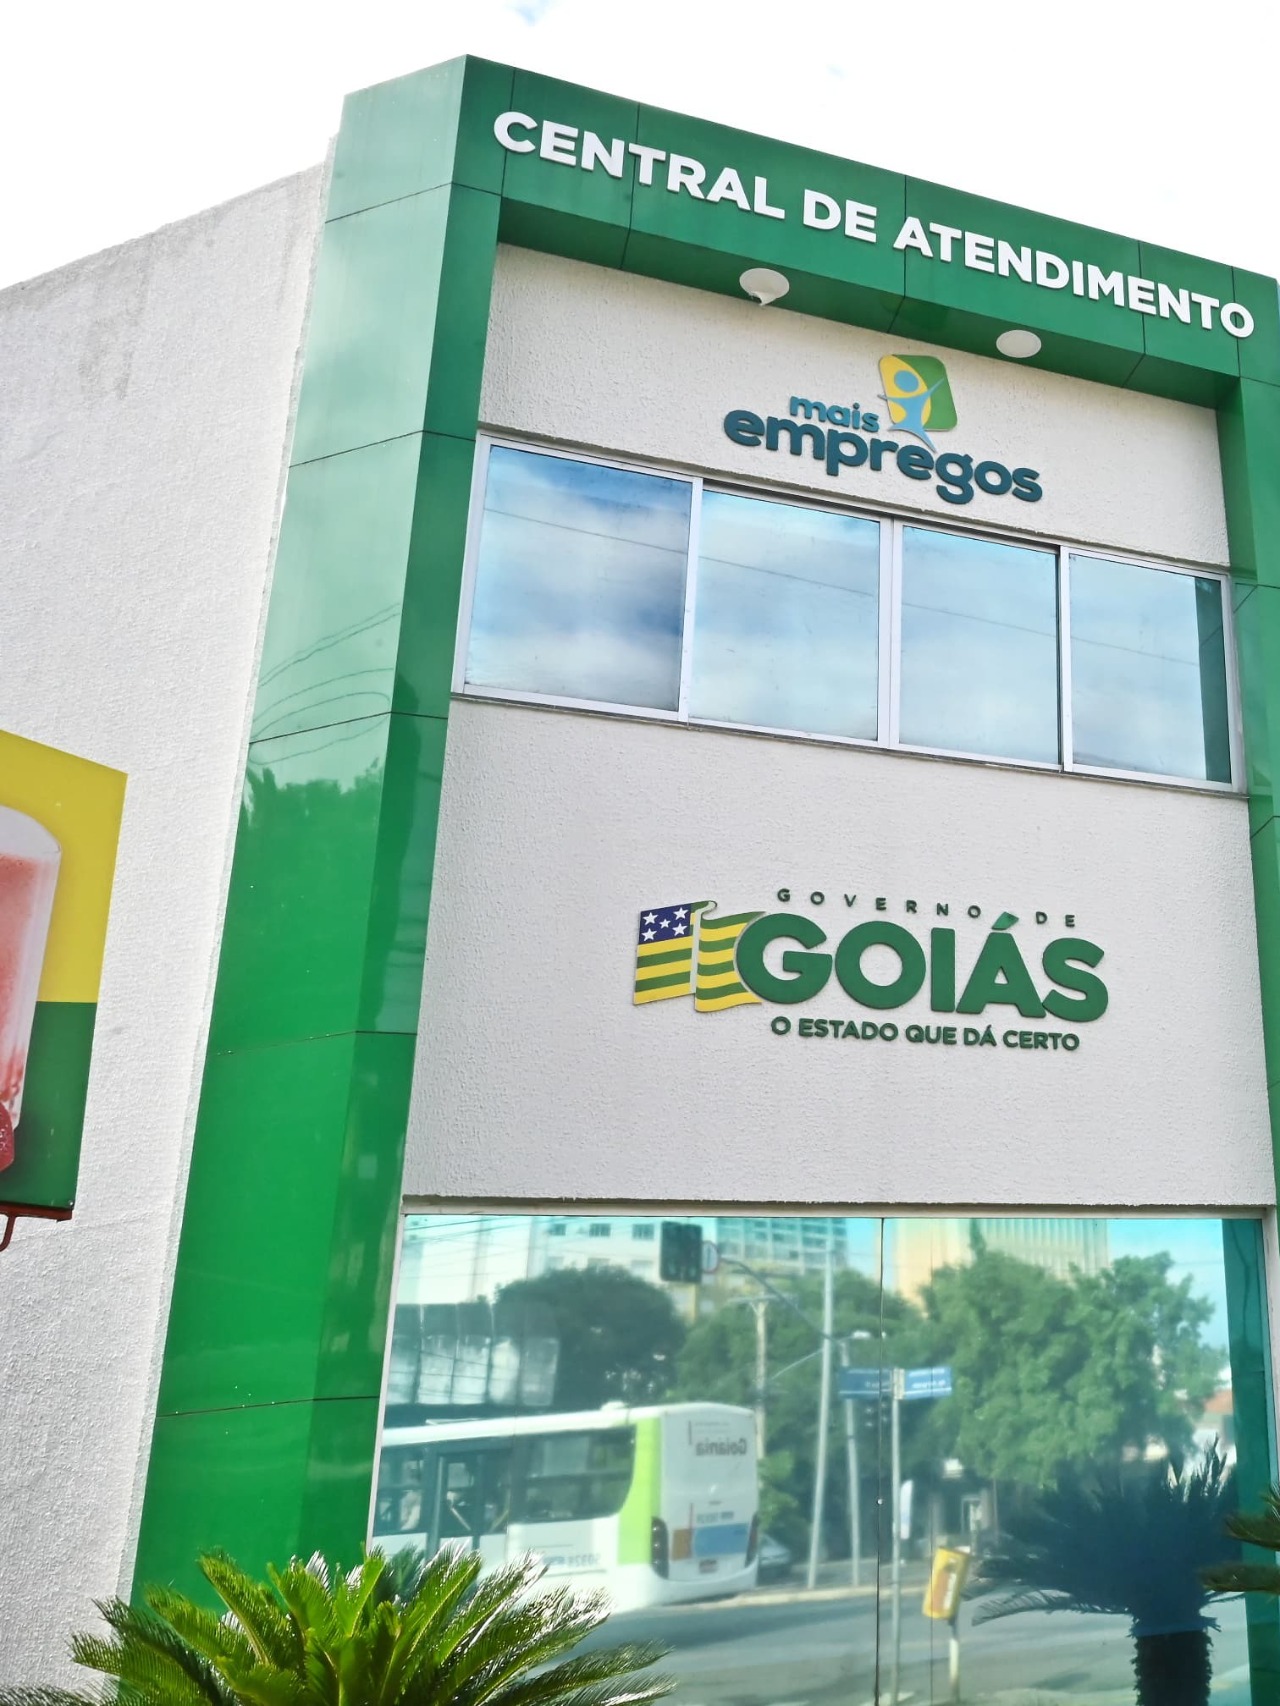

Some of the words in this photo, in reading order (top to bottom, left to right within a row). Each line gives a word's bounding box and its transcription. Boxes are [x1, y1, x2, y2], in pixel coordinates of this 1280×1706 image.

[493, 111, 785, 219] CENTRAL
[803, 189, 877, 243] DE
[892, 216, 1254, 338] ATENDIMENTO
[790, 396, 880, 433] mais
[723, 410, 1043, 505] empregos
[777, 888, 982, 919] GOVERNO
[1036, 911, 1076, 927] DE
[736, 911, 1109, 1022] GOIÁS
[771, 1016, 792, 1035] O
[799, 1018, 899, 1042] ESTADO
[905, 1024, 957, 1045] QUE
[963, 1025, 997, 1047] DÁ
[1003, 1029, 1080, 1051] CERTO
